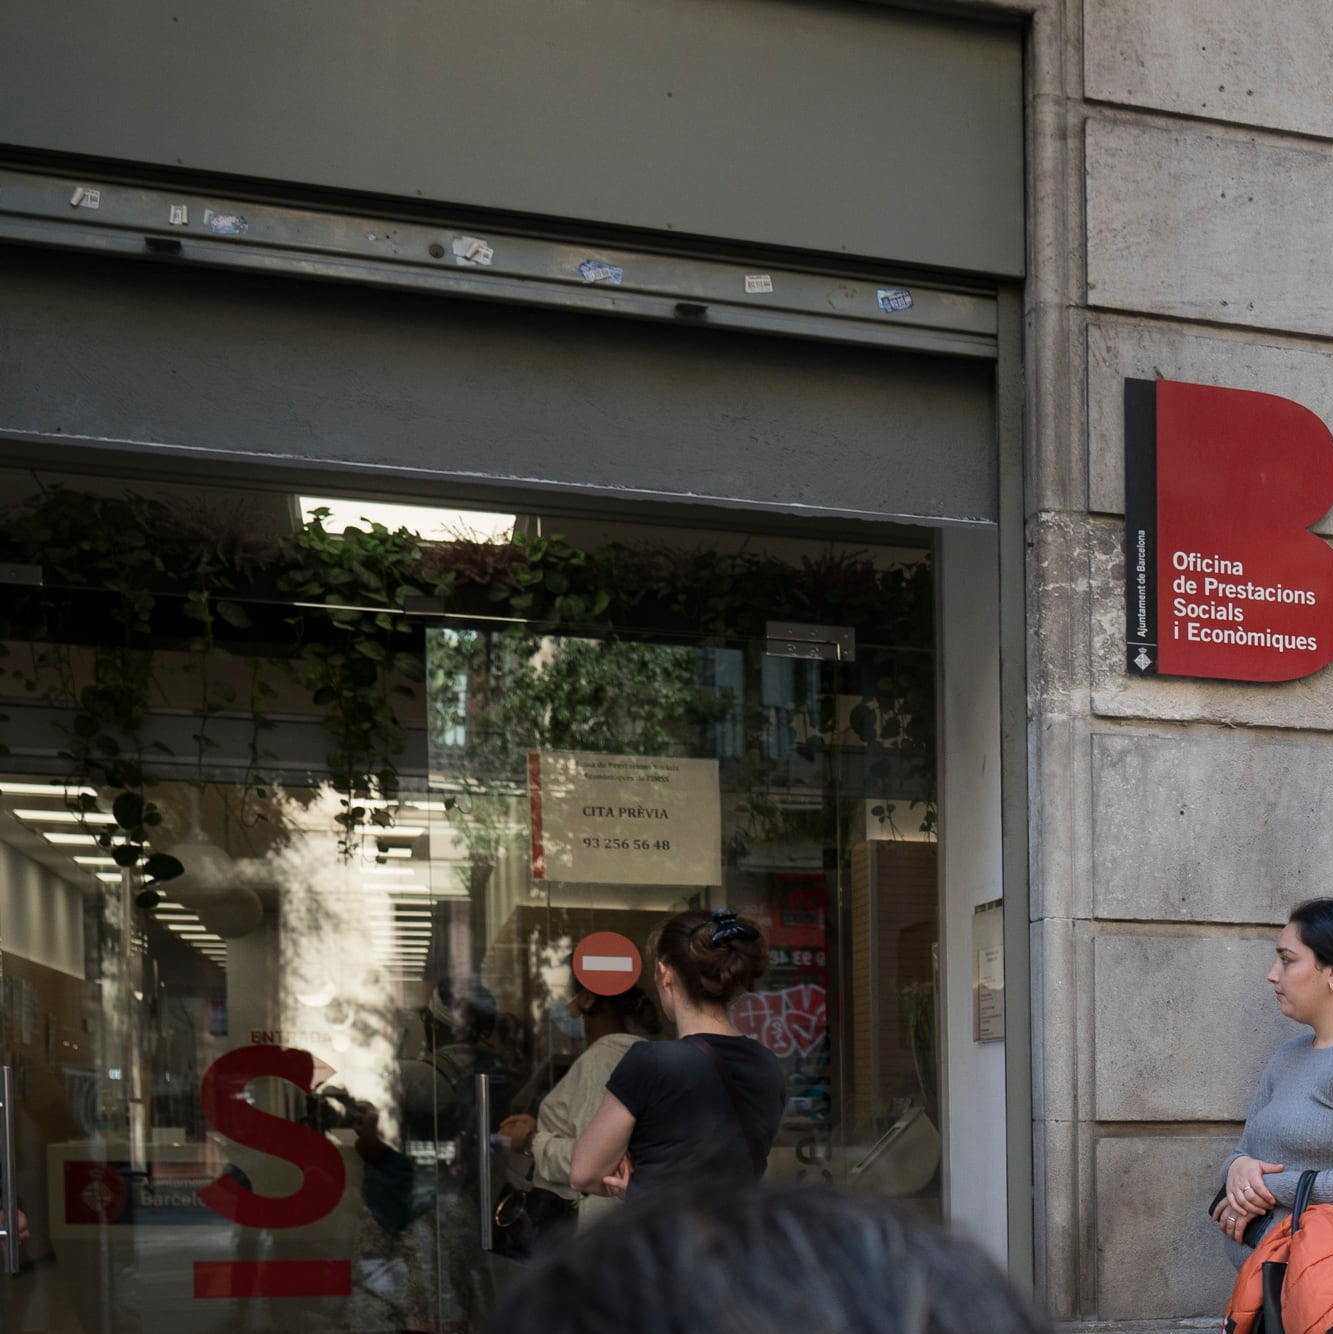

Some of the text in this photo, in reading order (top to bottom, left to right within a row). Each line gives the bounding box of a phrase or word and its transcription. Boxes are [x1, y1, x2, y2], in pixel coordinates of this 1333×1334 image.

[1172, 551, 1244, 576] Oficina
[1136, 530, 1148, 638] Ajuntament de Barcelona
[1173, 575, 1316, 606] de Prestacions
[1173, 598, 1244, 622] Socials
[1173, 622, 1318, 652] i Econòmiques
[582, 804, 669, 820] CITA PRÈVIA
[583, 838, 671, 851] 93 256 56 48
[139, 1190, 206, 1208] Barcel
